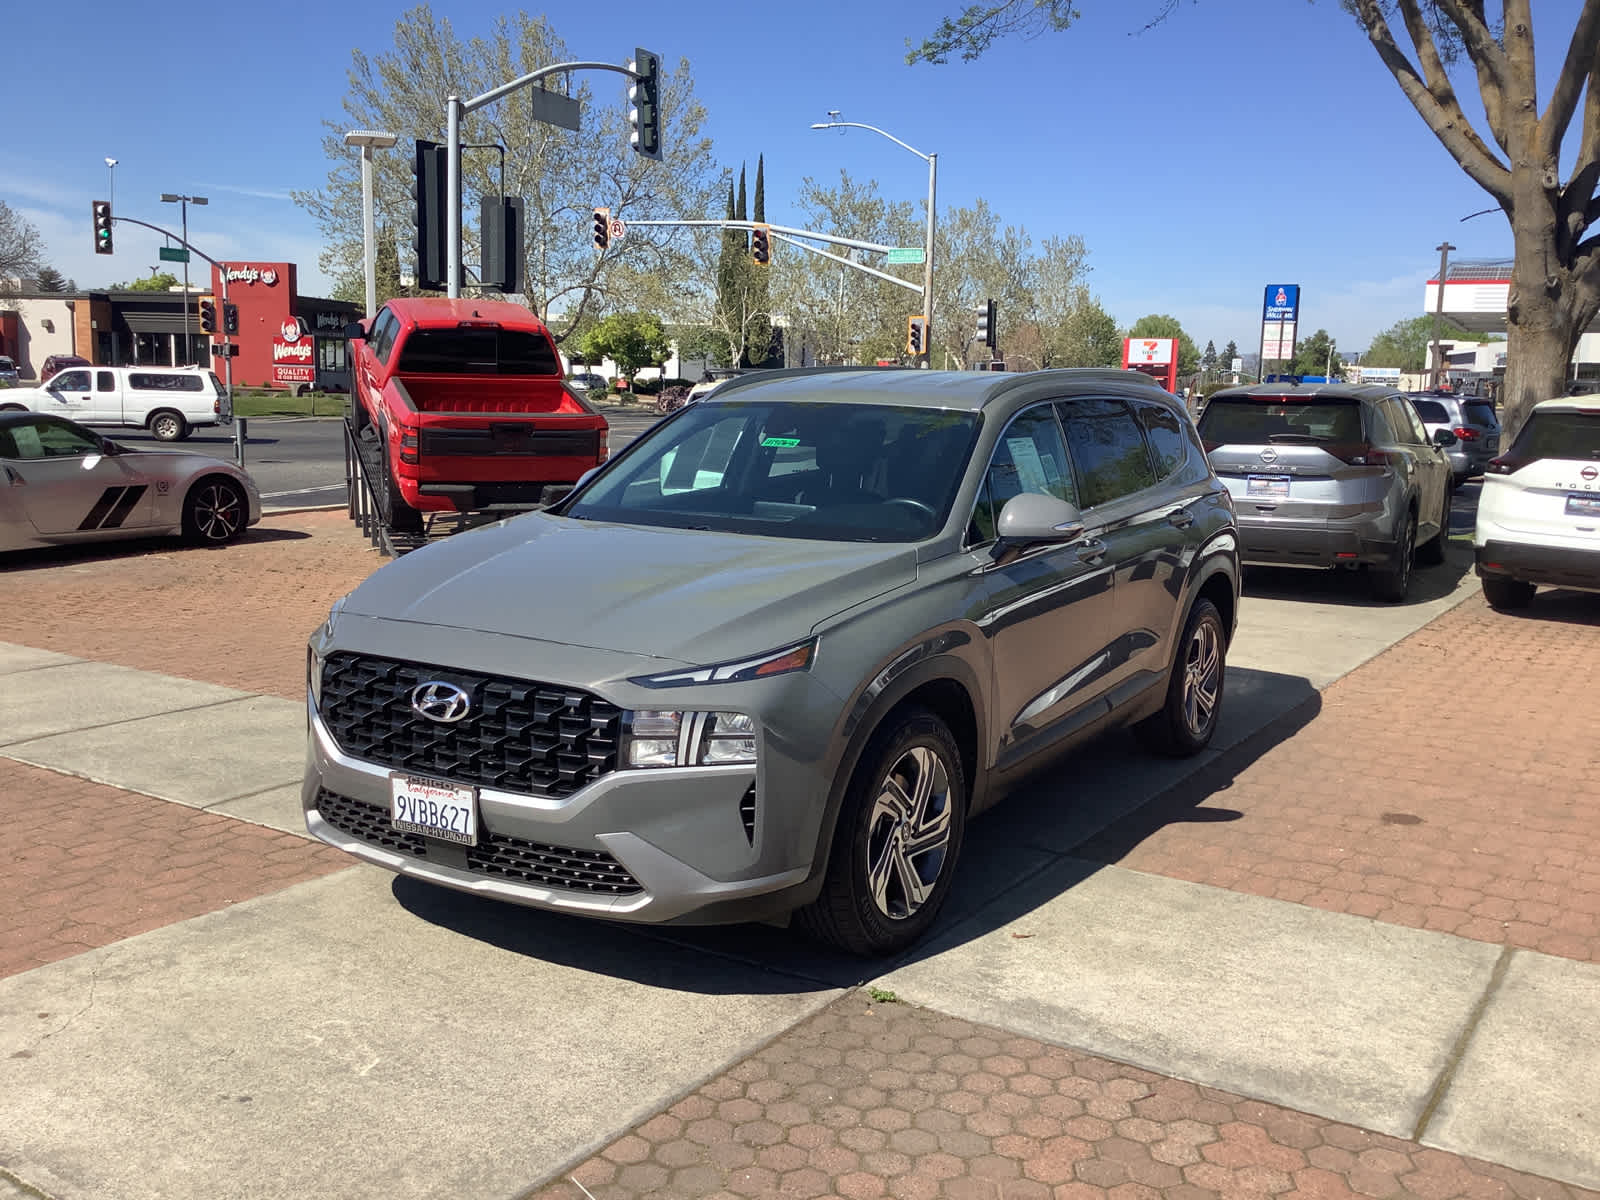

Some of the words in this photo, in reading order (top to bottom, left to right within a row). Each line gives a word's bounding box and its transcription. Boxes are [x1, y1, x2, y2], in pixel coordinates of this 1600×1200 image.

[273, 340, 311, 361] Wendy's
[409, 776, 454, 790] CHICO
[397, 795, 470, 833] 9VBB627
